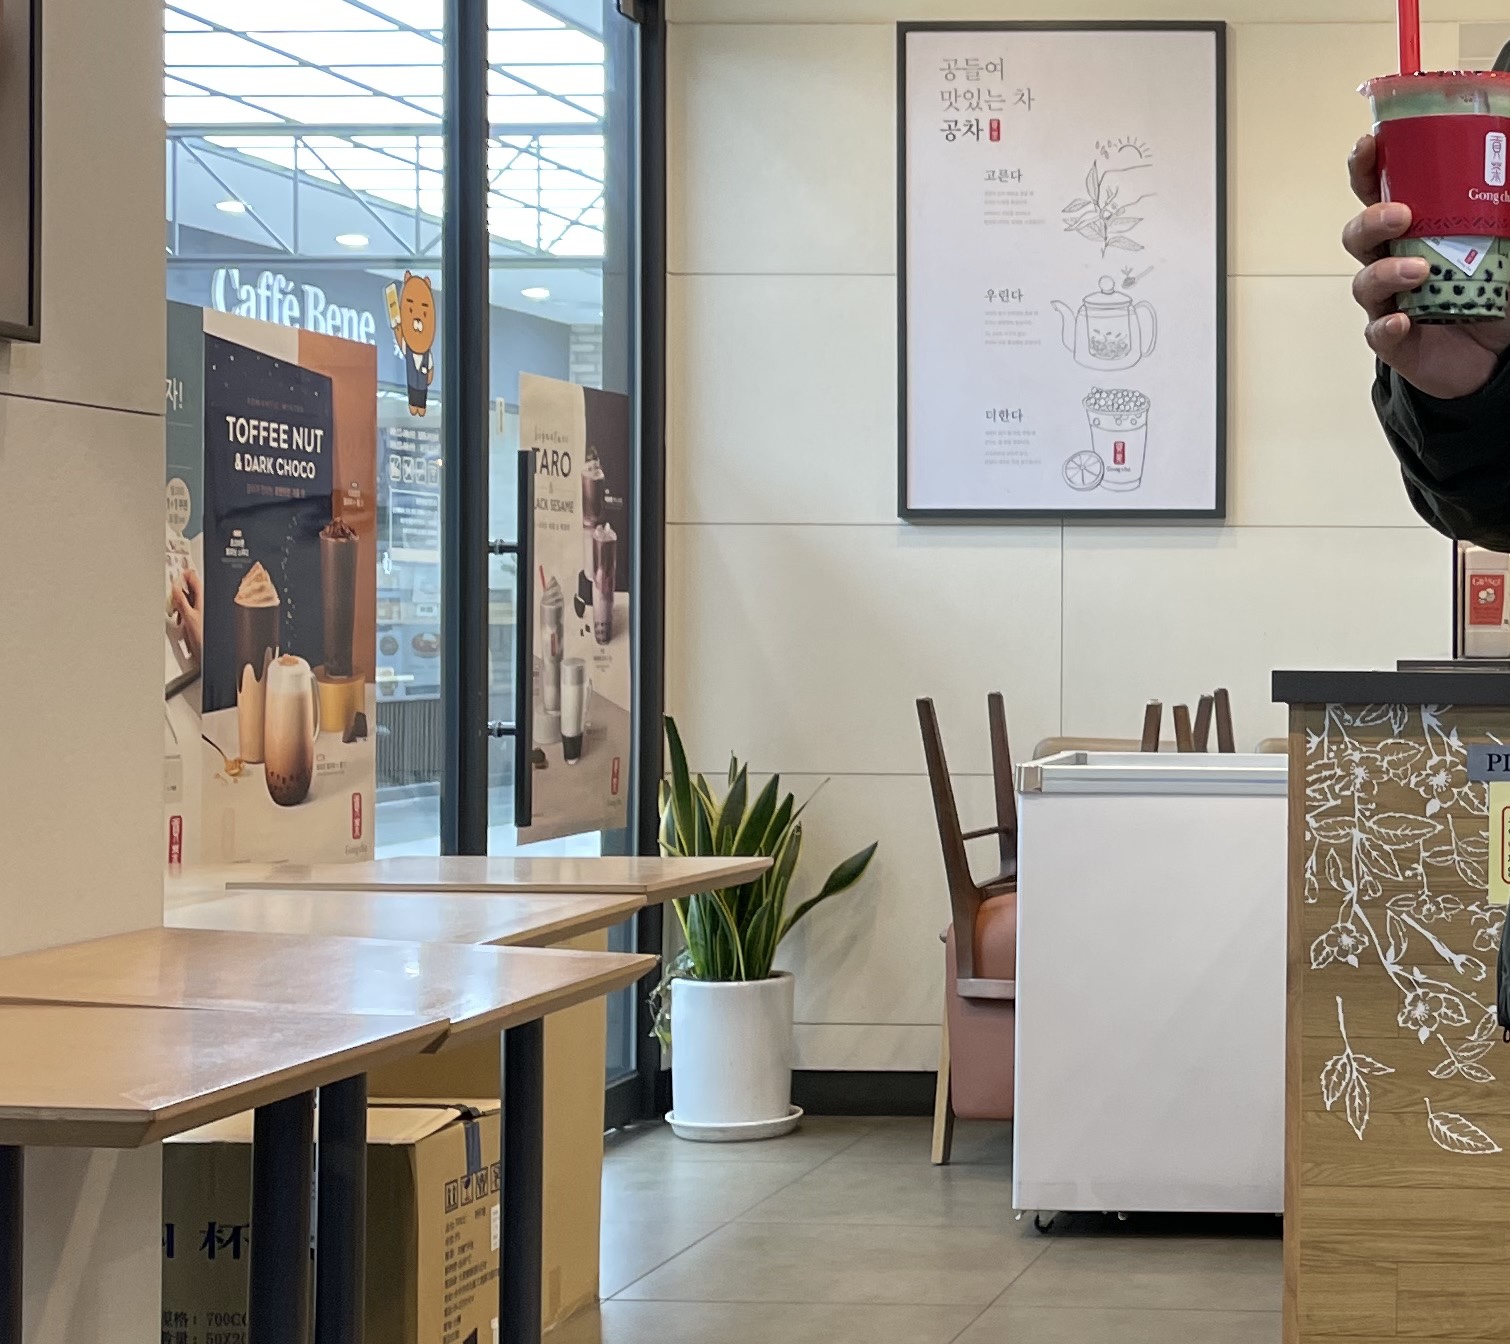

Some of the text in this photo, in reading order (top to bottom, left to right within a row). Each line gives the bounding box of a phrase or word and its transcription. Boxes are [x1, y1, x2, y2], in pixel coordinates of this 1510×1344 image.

[939, 57, 1004, 82] 공들여
[940, 87, 1035, 112] 맛있는 차
[940, 118, 984, 142] 공차
[984, 169, 1023, 183] 고른다
[1468, 188, 1499, 205] Gong
[211, 268, 376, 346] Caffé Bene
[226, 416, 324, 453] TOFFEE NUT
[234, 453, 316, 479] & DARK CHOCO
[532, 447, 572, 477] TARO
